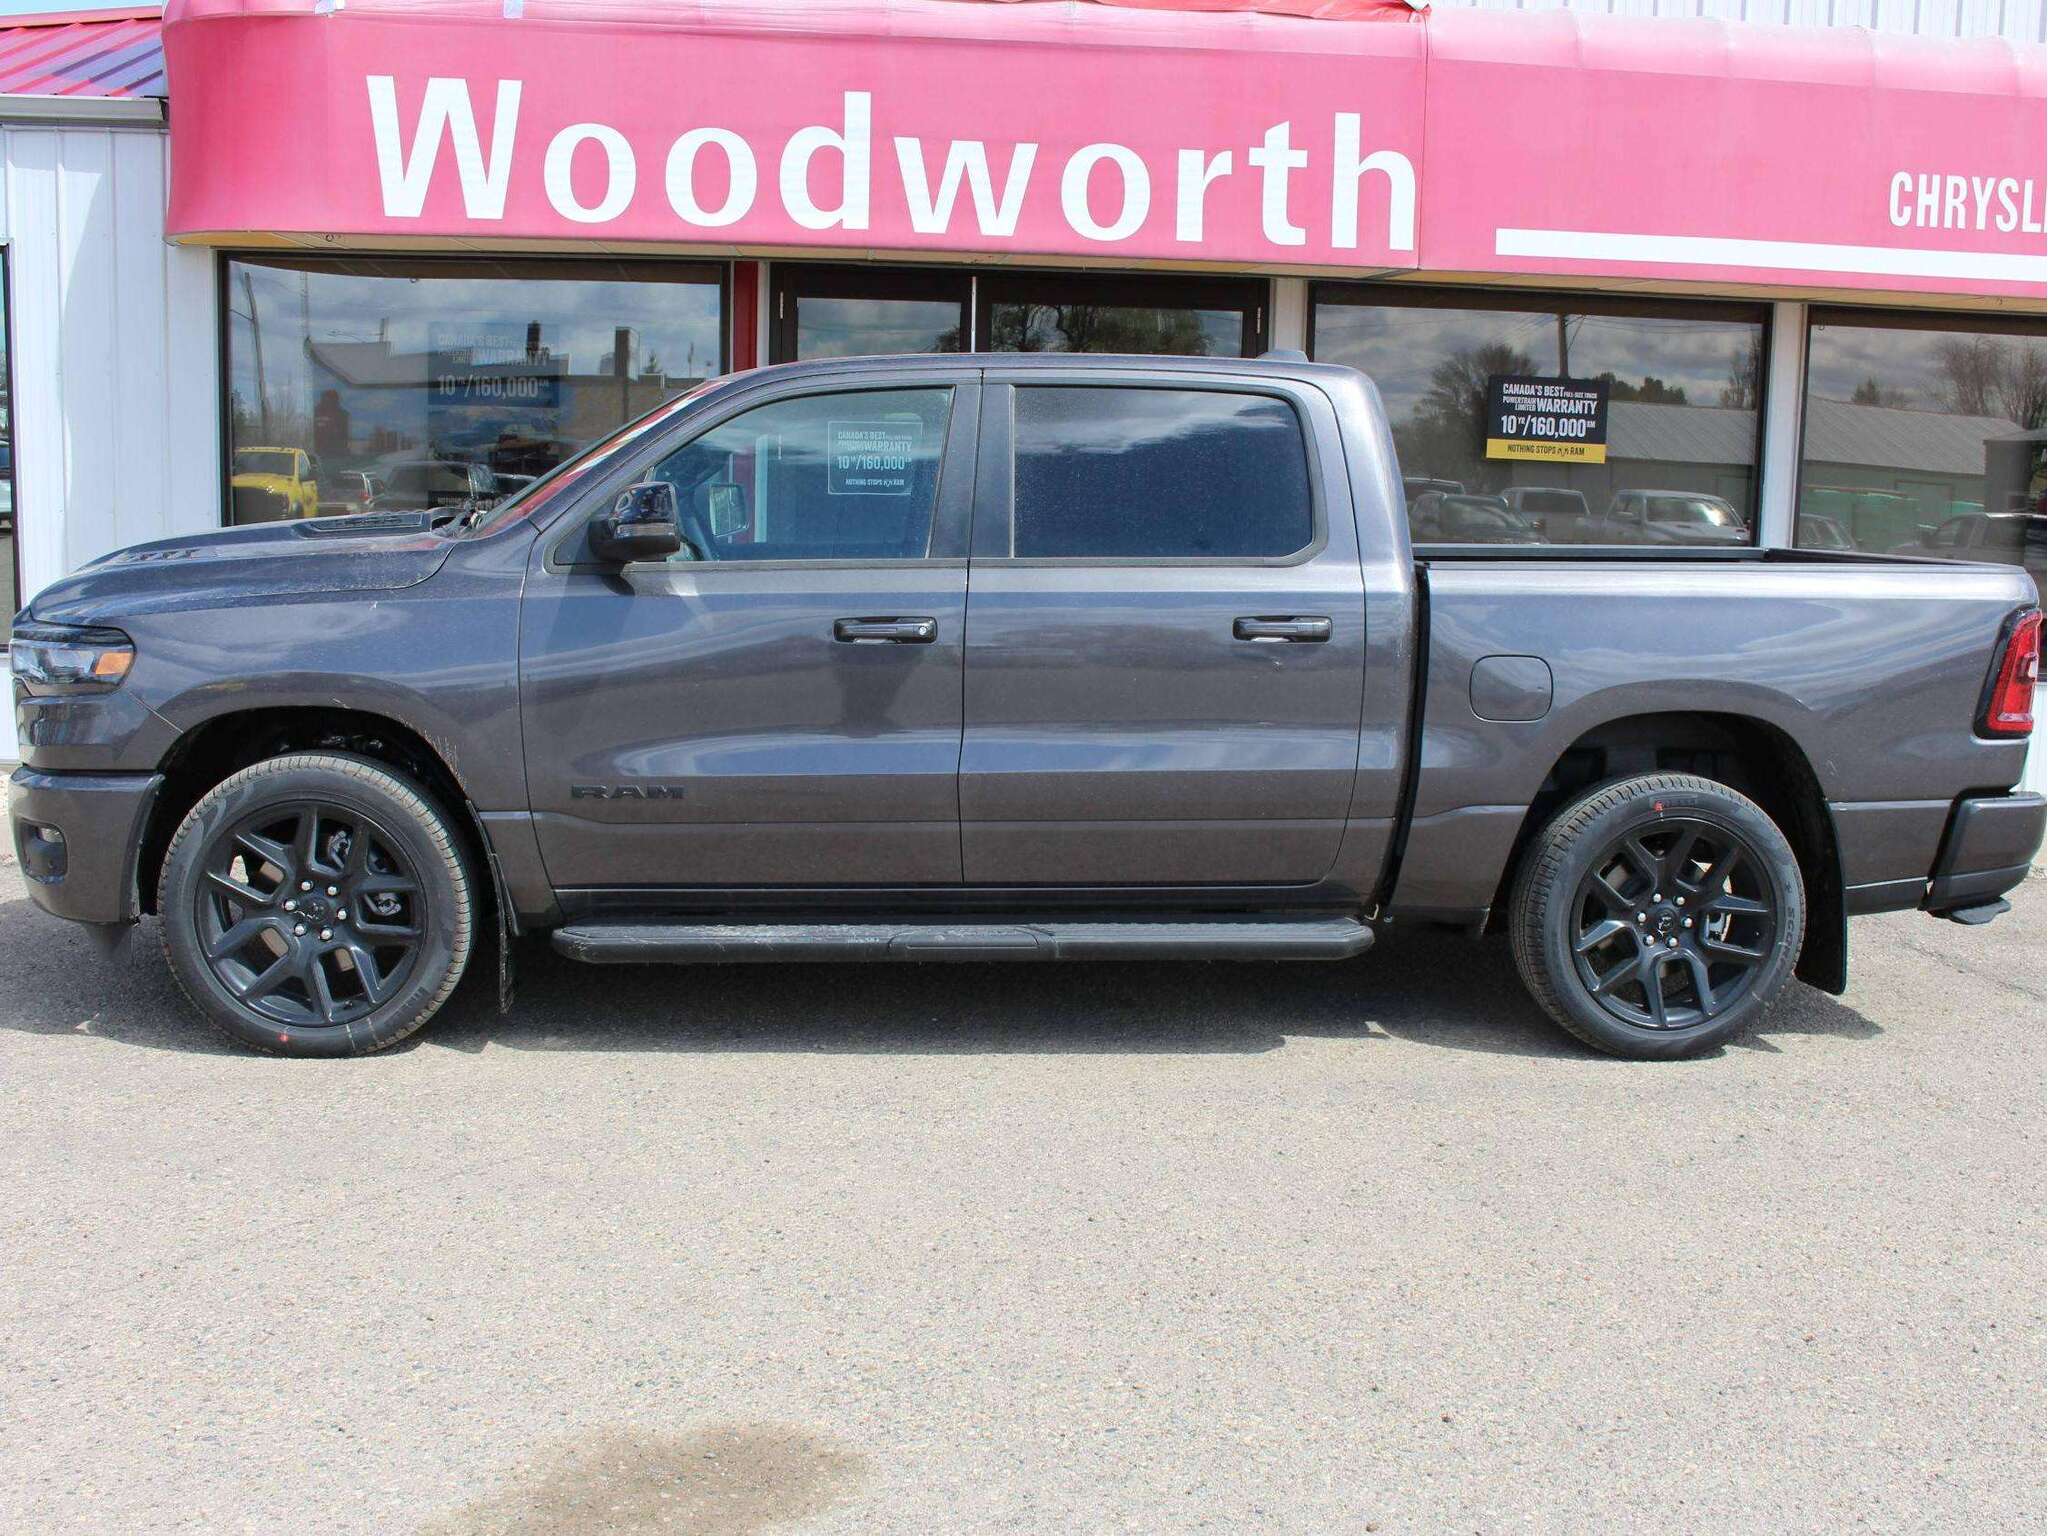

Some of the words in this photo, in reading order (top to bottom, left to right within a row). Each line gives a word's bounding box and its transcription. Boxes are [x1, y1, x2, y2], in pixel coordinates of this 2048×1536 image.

[366, 75, 1416, 251] Woodworth
[1889, 171, 2047, 233] CHRYSL
[1502, 383, 1543, 396] CANADA'S
[1543, 385, 1565, 397] BEST
[1514, 402, 1537, 412] LIMITED
[1536, 398, 1598, 415] WARRANTY
[863, 440, 912, 452] WARRANTY
[1507, 444, 1534, 454] NOTHING
[1535, 445, 1556, 455] STOPS
[1569, 446, 1585, 456] RAM
[571, 784, 685, 800] RAM
